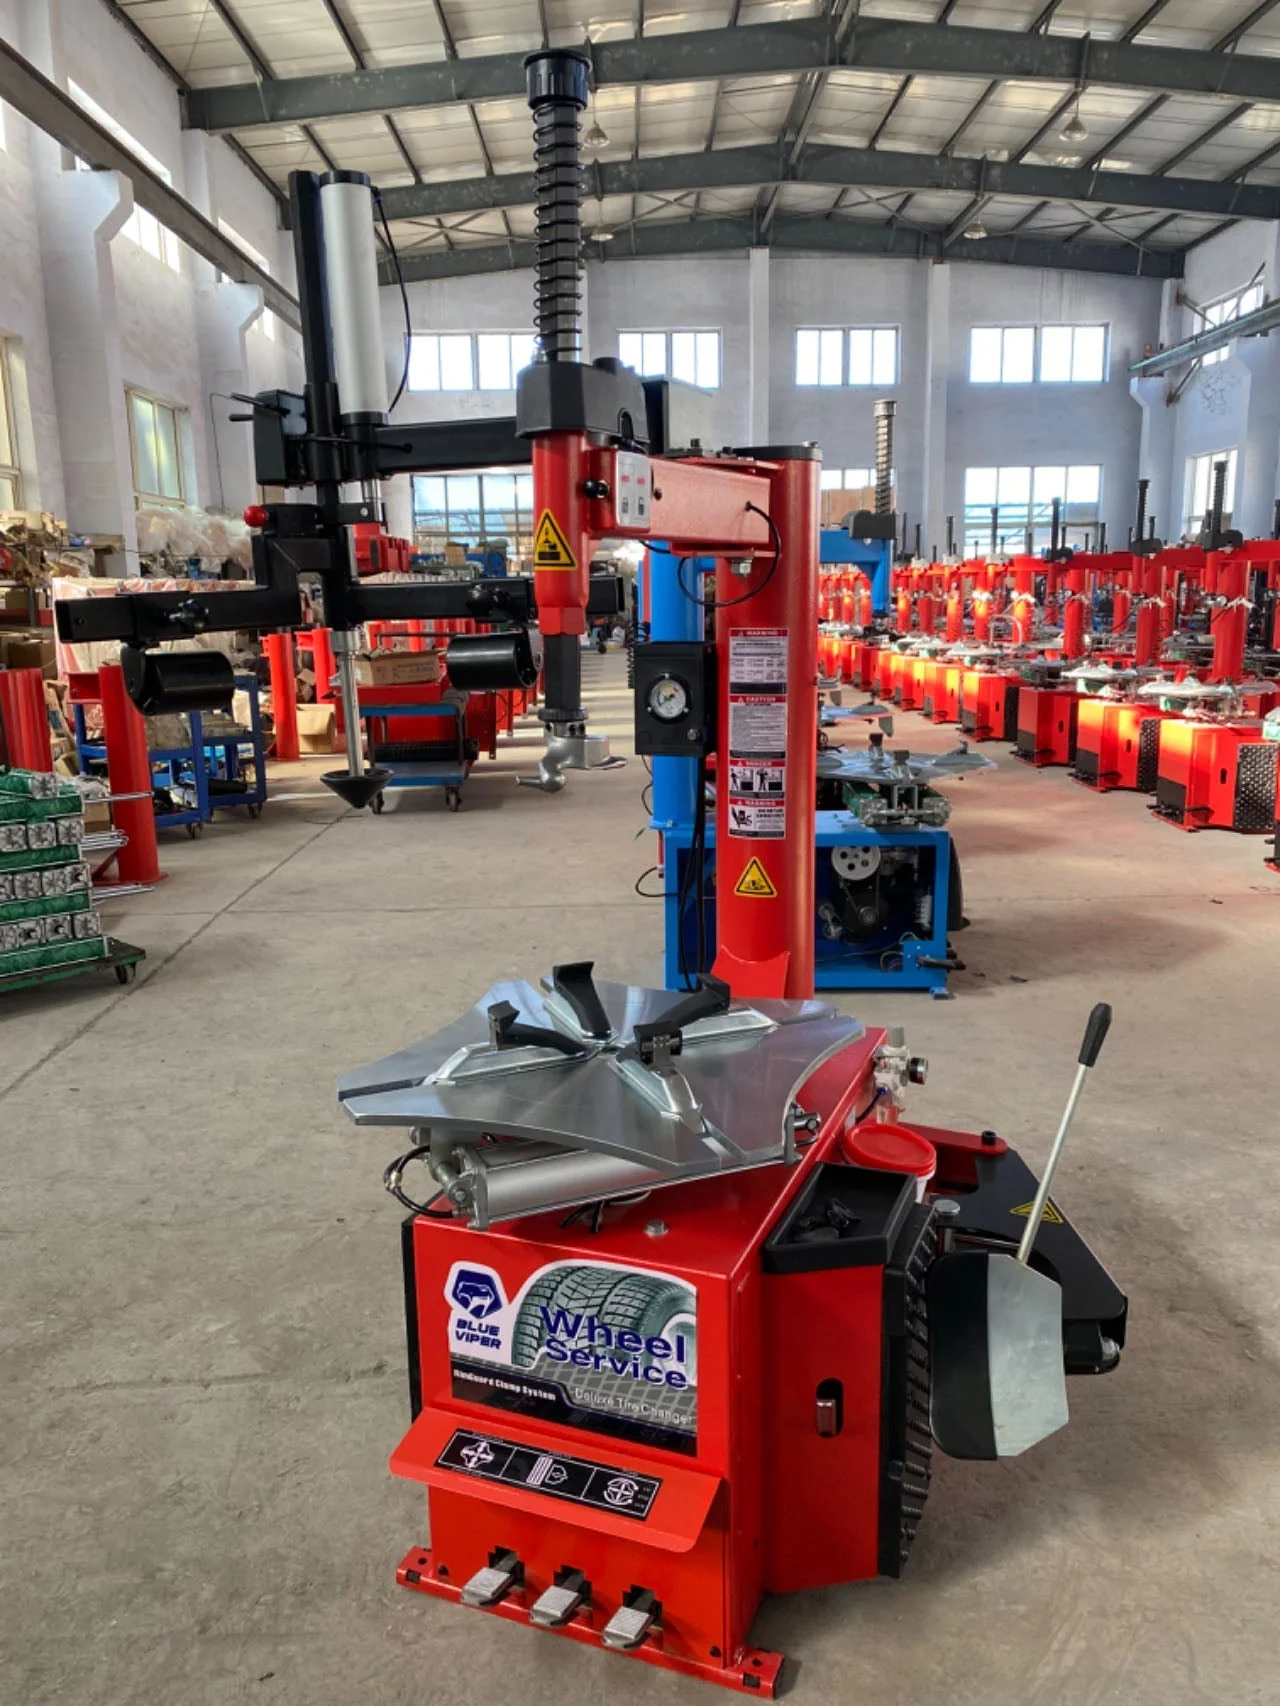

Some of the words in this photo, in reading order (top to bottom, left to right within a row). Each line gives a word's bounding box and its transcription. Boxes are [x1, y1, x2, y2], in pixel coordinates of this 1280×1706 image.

[455, 1330, 502, 1349] VIPER
[457, 1318, 500, 1336] BLUE
[540, 1306, 685, 1363] Wheel
[545, 1338, 687, 1389] Service
[495, 1379, 521, 1393] Clamp
[522, 1386, 556, 1401] System
[575, 1387, 614, 1406] Deluxe
[616, 1397, 640, 1411] Tire
[641, 1404, 694, 1424] Changer
